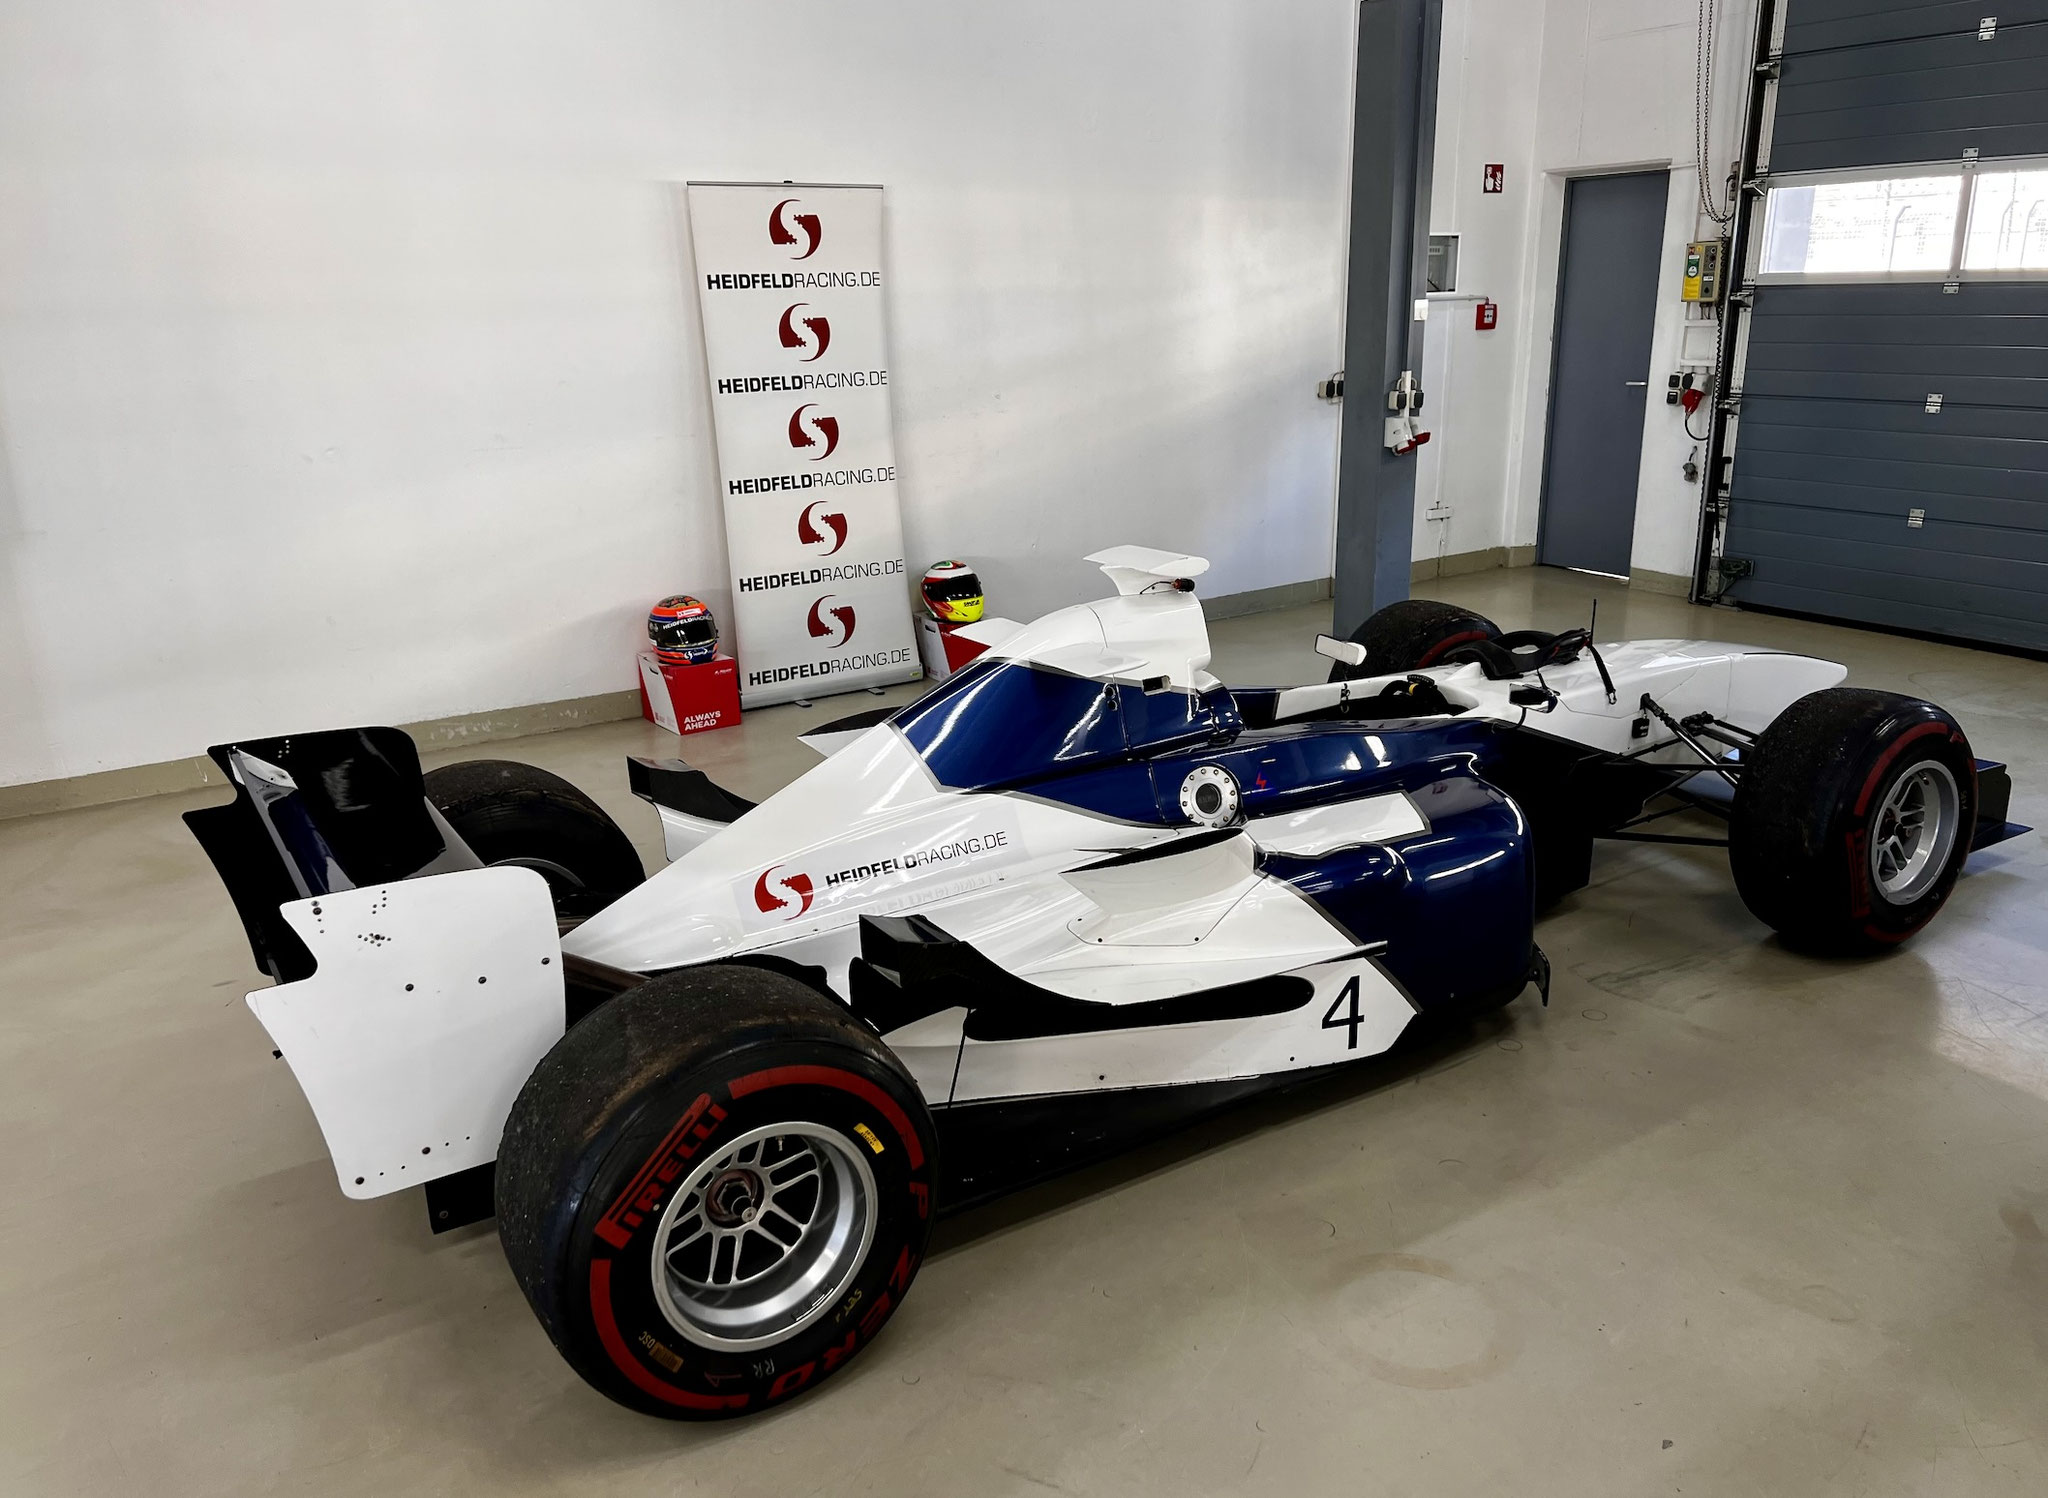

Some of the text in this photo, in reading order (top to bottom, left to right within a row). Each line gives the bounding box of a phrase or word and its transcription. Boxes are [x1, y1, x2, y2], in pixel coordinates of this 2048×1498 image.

[707, 272, 880, 290] HEIDFELDRACING.DE
[718, 371, 887, 394] HEIDFELDRACING.DE
[728, 466, 895, 495] HEIDFELDRACING.DE
[739, 559, 903, 592] HEIDFELDRACING.DE
[749, 648, 910, 686] HEIDFELDRACING.DE
[683, 711, 721, 724] ALWAYS
[684, 719, 717, 731] AHEAD
[825, 831, 1008, 889] HEIDFELDRACING.DE
[1321, 975, 1365, 1050] 4
[593, 1093, 728, 1249] PIRELLI
[768, 1242, 916, 1400] ZERO
